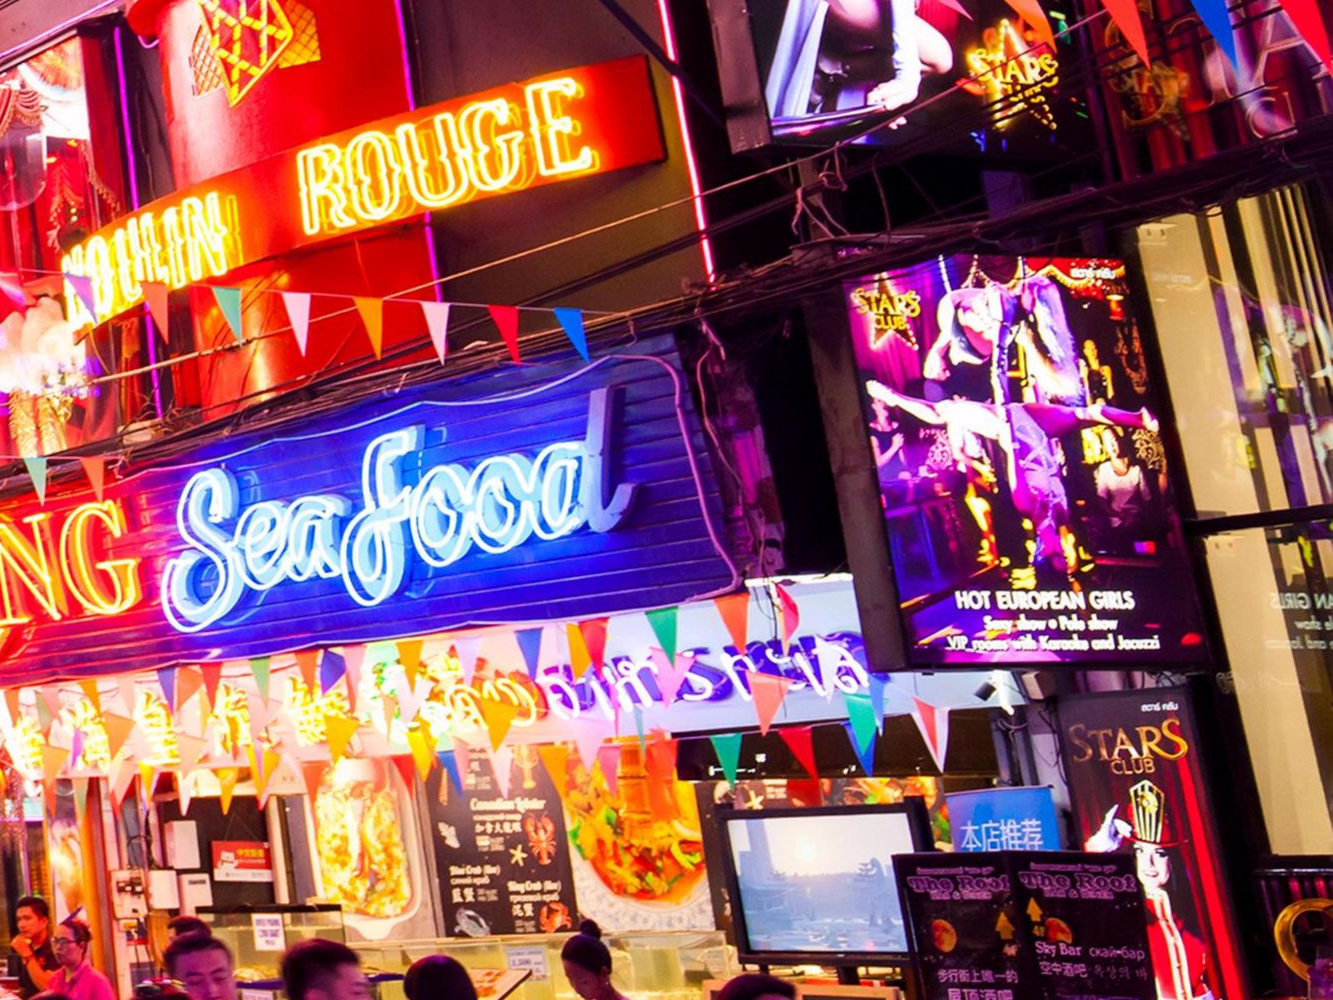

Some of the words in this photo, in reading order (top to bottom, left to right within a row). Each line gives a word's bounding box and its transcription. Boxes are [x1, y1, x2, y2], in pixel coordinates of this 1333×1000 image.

[296, 75, 599, 237] ROUGE
[852, 287, 921, 318] STARS
[874, 315, 907, 330] CLUB
[954, 590, 991, 610] HOT
[995, 590, 1086, 610] EUROPEAN
[1088, 590, 1136, 610] GIRLS
[983, 615, 1014, 634] Sexy
[1015, 614, 1048, 631] show
[1058, 614, 1086, 631] Pole
[1088, 614, 1119, 631] show
[947, 635, 969, 651] VIP
[972, 639, 1010, 651] rooms
[1012, 634, 1038, 650] with
[1039, 634, 1090, 651] Karaoke
[1091, 634, 1115, 650] and
[1118, 634, 1161, 650] Jacuzzi
[1068, 717, 1190, 764] STARS
[1110, 757, 1156, 775] CLUB
[959, 820, 1044, 852] 本店推荐
[1018, 871, 1071, 889] The
[1074, 872, 1137, 892] Roof
[1034, 940, 1057, 958] Sky
[1058, 942, 1083, 956] Bar
